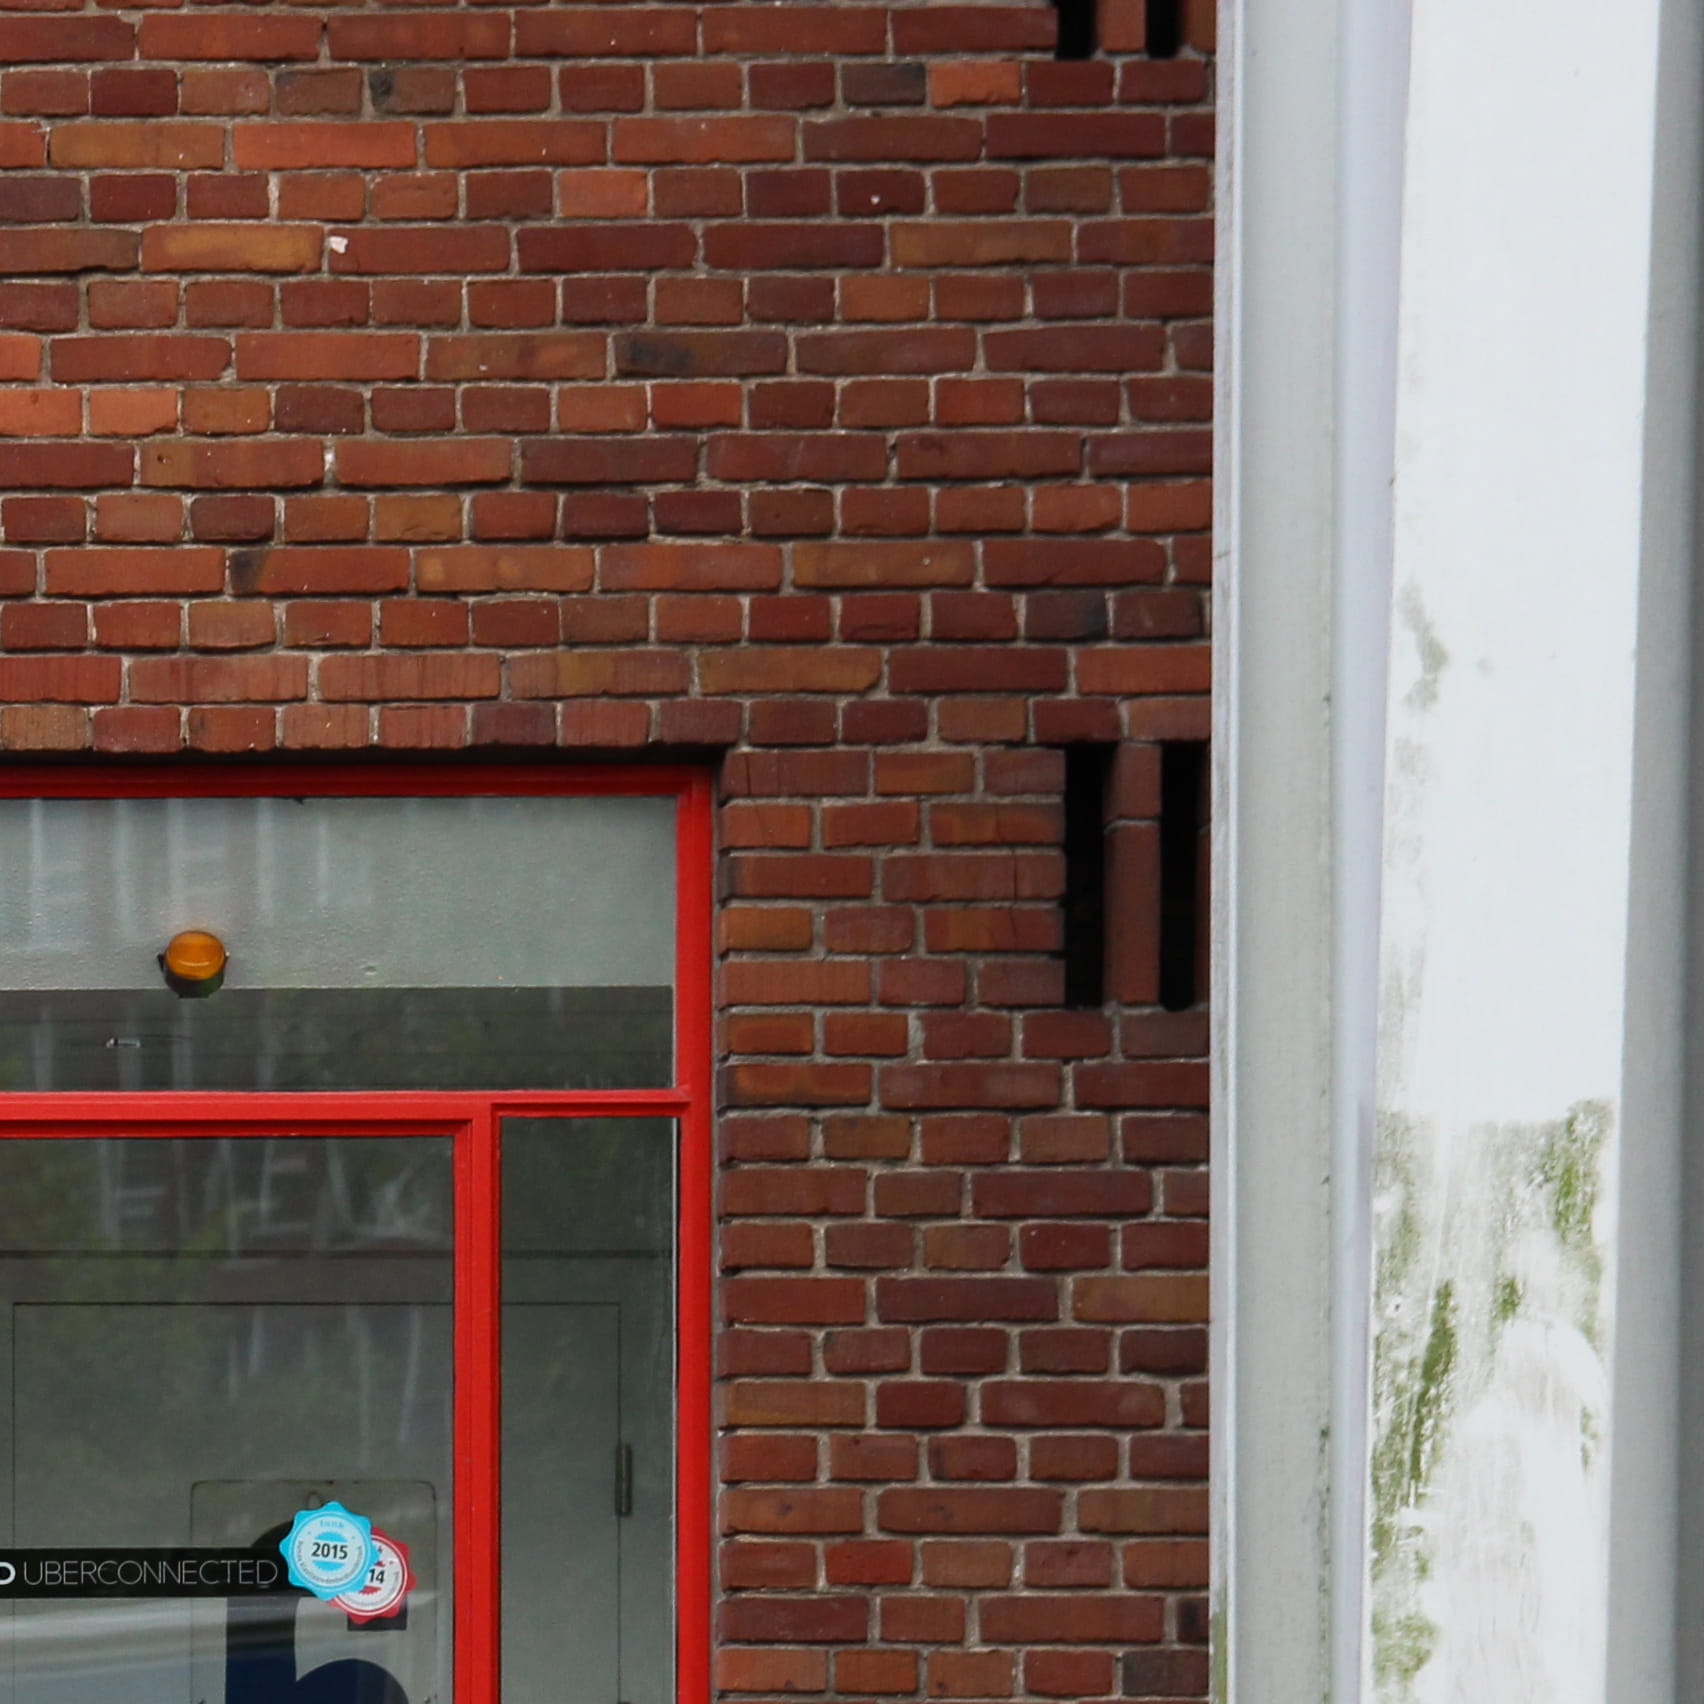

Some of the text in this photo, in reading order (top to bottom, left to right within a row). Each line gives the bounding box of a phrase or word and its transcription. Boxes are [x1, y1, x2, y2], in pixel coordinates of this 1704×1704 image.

[311, 1542, 348, 1559] 2015
[23, 1559, 278, 1586] UBERCONNECTED
[369, 1568, 385, 1584] 14
